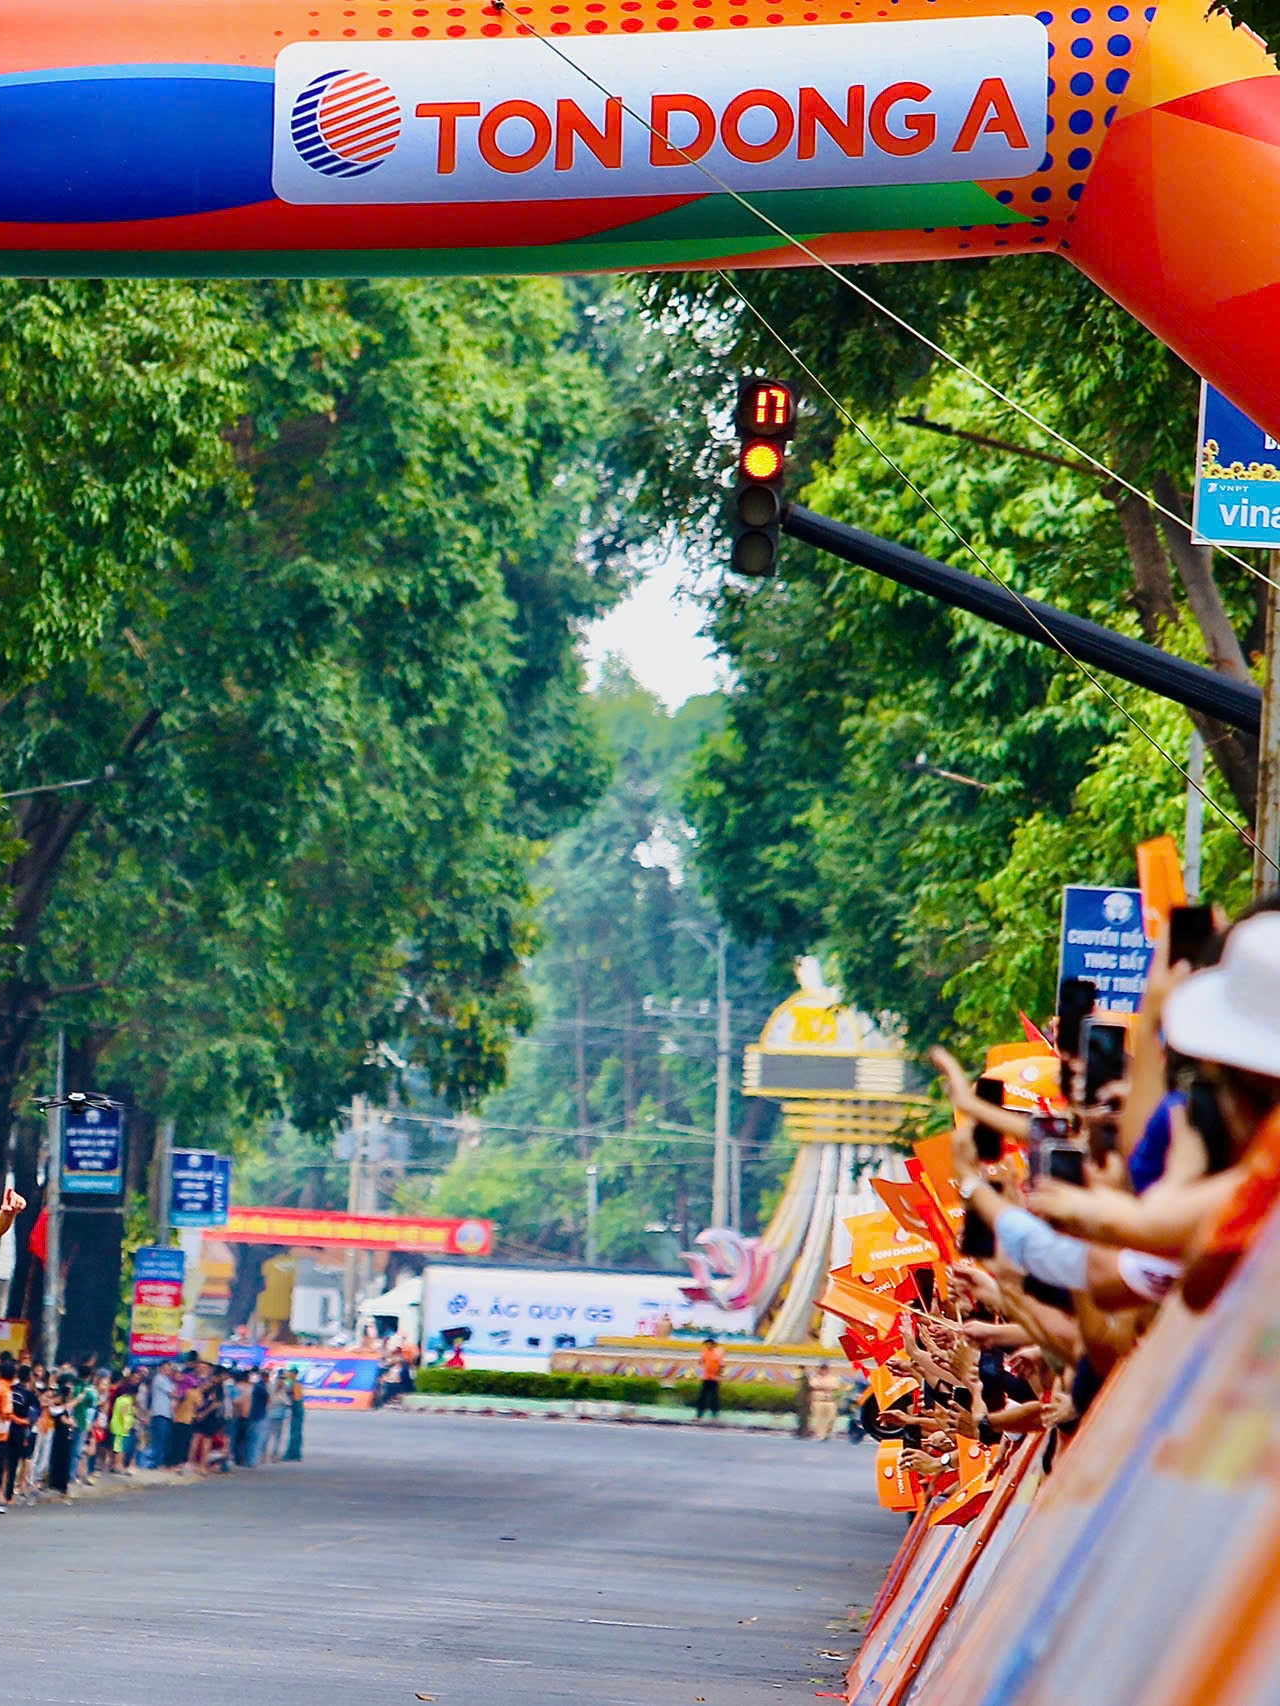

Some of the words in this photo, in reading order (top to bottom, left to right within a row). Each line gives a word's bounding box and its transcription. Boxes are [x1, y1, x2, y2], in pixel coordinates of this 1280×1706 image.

[415, 96, 622, 175] TON
[648, 81, 936, 167] DONG
[953, 77, 1030, 153] A
[756, 389, 786, 424] 17
[1220, 485, 1249, 493] VNPT
[893, 1243, 924, 1257] DONG
[528, 1304, 577, 1320] QUY
